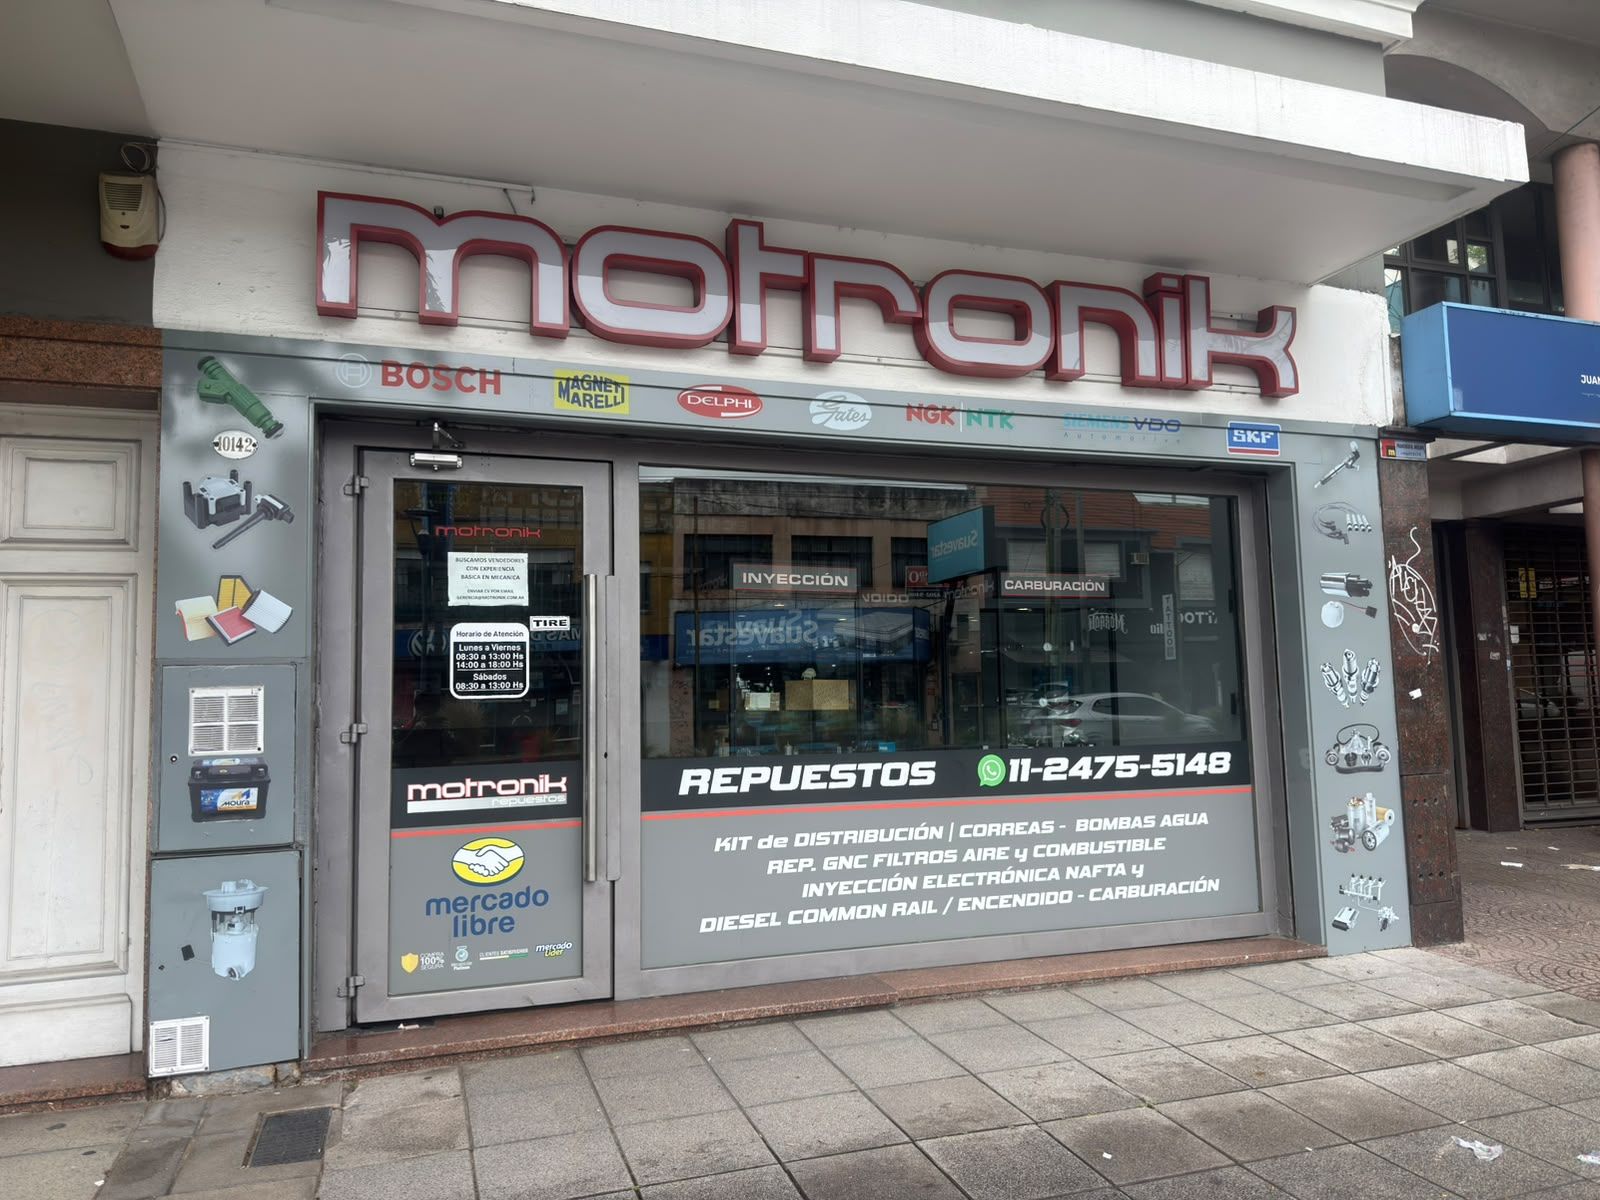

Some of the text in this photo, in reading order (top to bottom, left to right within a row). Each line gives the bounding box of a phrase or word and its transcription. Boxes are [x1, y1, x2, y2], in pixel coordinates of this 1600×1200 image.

[317, 191, 1299, 397] motronik
[381, 360, 501, 395] BOSCH
[687, 395, 753, 408] DELPHI
[817, 393, 869, 424] Gates
[906, 402, 1014, 430] NGK NTK
[1133, 416, 1181, 432] VDO
[218, 436, 252, 452] 10142
[1232, 429, 1274, 443] SKF
[435, 525, 542, 538] motronik
[742, 572, 849, 587] INYECCIÓN
[1004, 578, 1106, 593] CARBURACIÓN
[533, 619, 568, 627] TIRE
[455, 682, 479, 690] 08:30
[678, 751, 1232, 796] REPUESTOS 11-2475-5148
[407, 773, 567, 800] motronik
[492, 795, 566, 808] repuestos
[714, 835, 753, 852] KIT
[757, 834, 788, 850] de
[793, 822, 944, 847] DISTRIBUCIÓN
[959, 820, 1055, 838] CORREAS
[1075, 815, 1156, 832] BOMBAS
[1160, 812, 1209, 828] AGUA
[767, 837, 1167, 875] REP. GNC FILTROS AIRE y COMBUSTIBLE
[802, 863, 1145, 898] INYECCIÓN ELECTRÓNICA NAFTA y
[425, 886, 549, 916] mercado
[699, 911, 782, 934] DIESEL
[787, 903, 888, 925] COMMON
[891, 899, 938, 917] RAIL
[957, 890, 1073, 912] ENCENDIDO
[1089, 875, 1220, 902] CARBURACIÓN
[453, 914, 516, 938] libre
[535, 941, 573, 952] mercado
[420, 956, 445, 966] 100%
